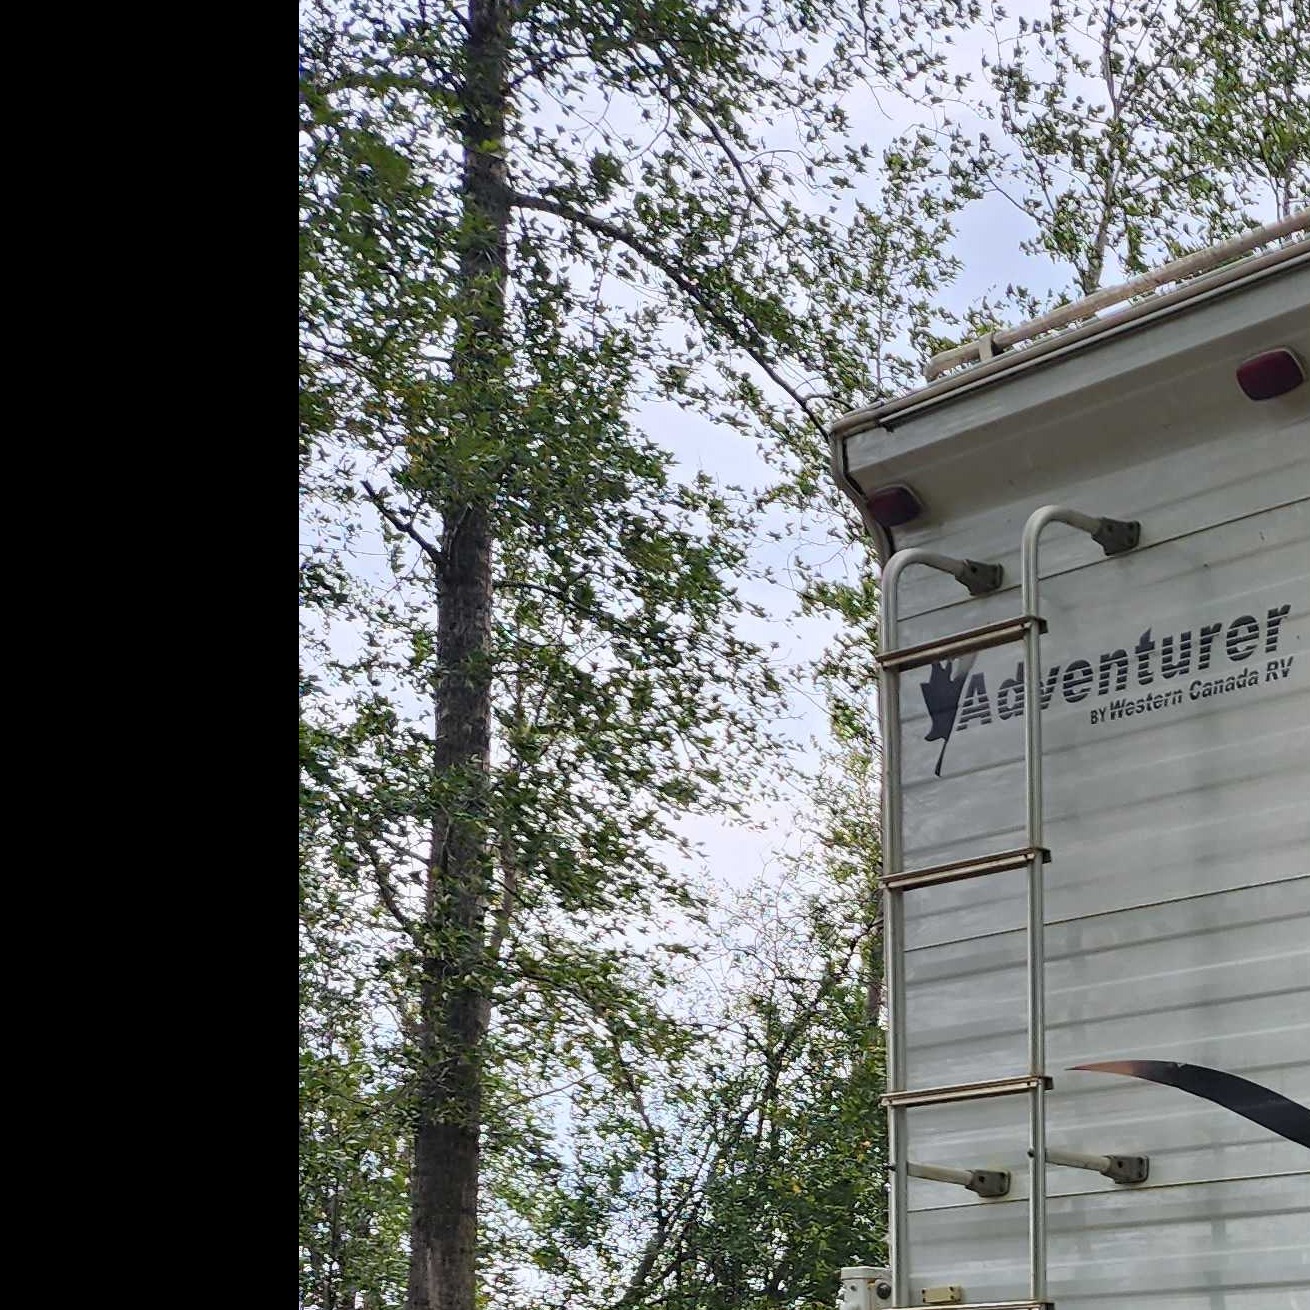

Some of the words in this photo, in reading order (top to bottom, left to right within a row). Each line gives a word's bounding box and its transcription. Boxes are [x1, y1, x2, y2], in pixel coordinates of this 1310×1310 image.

[956, 604, 1292, 732] Adventurer
[1090, 707, 1107, 725] BY
[1109, 688, 1183, 721] Western
[1189, 667, 1259, 701] Canada
[1265, 655, 1295, 682] RV
